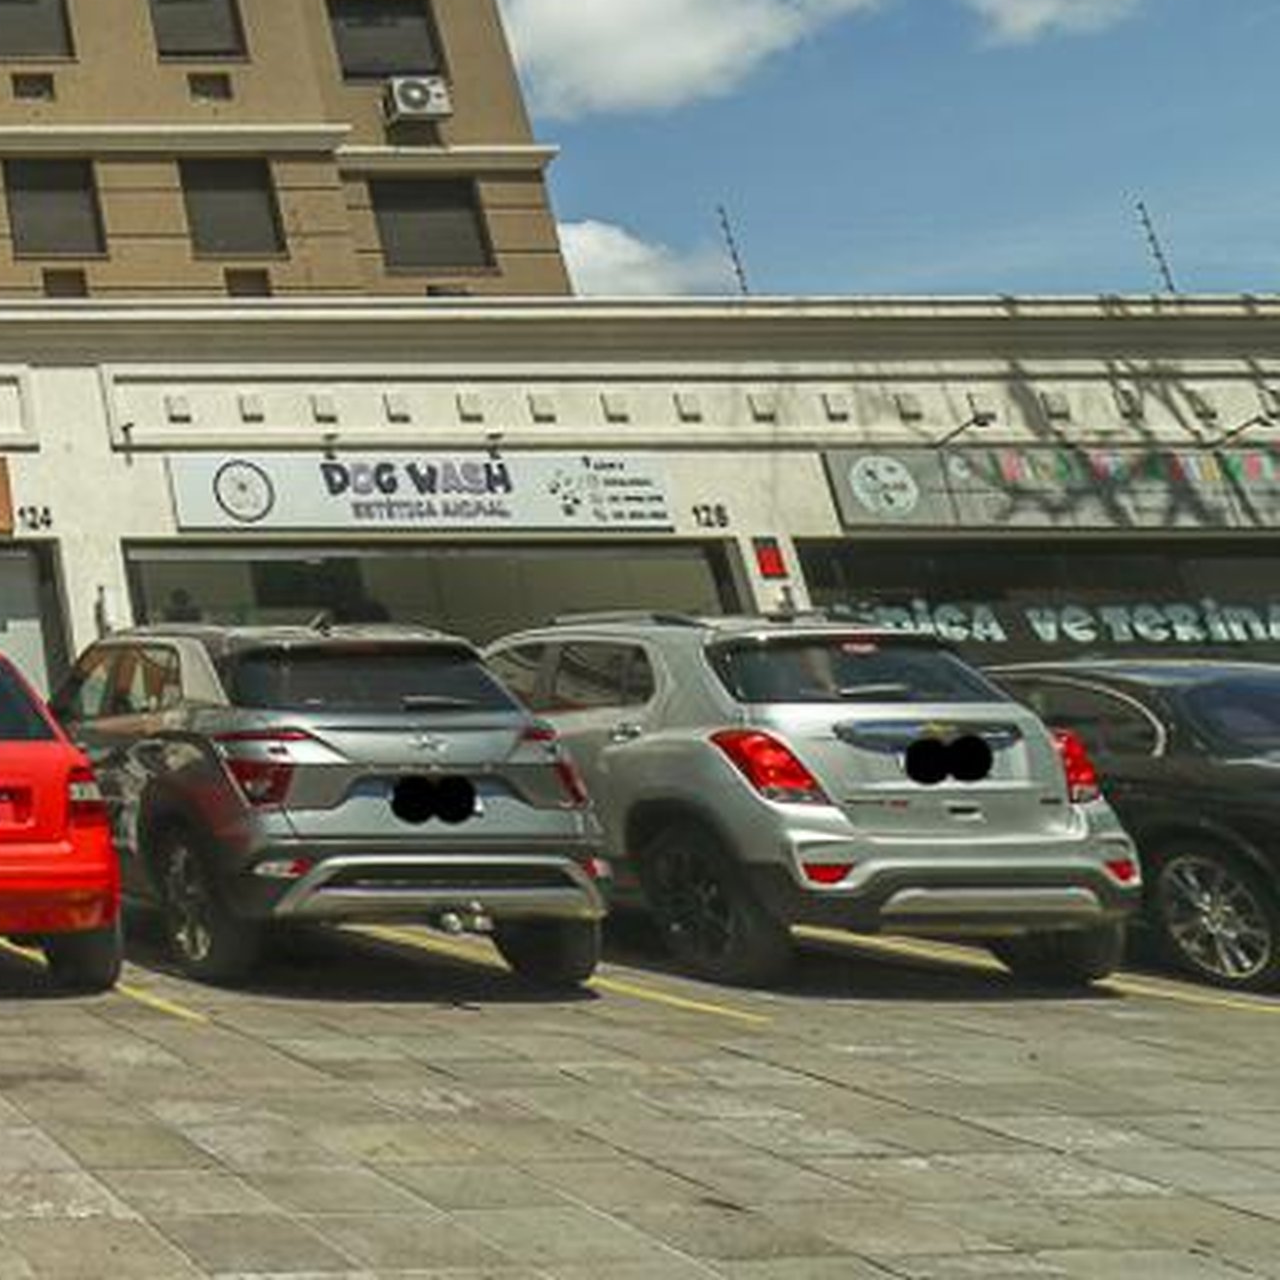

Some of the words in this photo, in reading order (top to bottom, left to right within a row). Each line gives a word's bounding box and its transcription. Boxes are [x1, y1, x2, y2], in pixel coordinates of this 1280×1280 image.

[320, 462, 398, 496] DOG
[405, 462, 512, 495] WASH
[17, 505, 52, 530] 124
